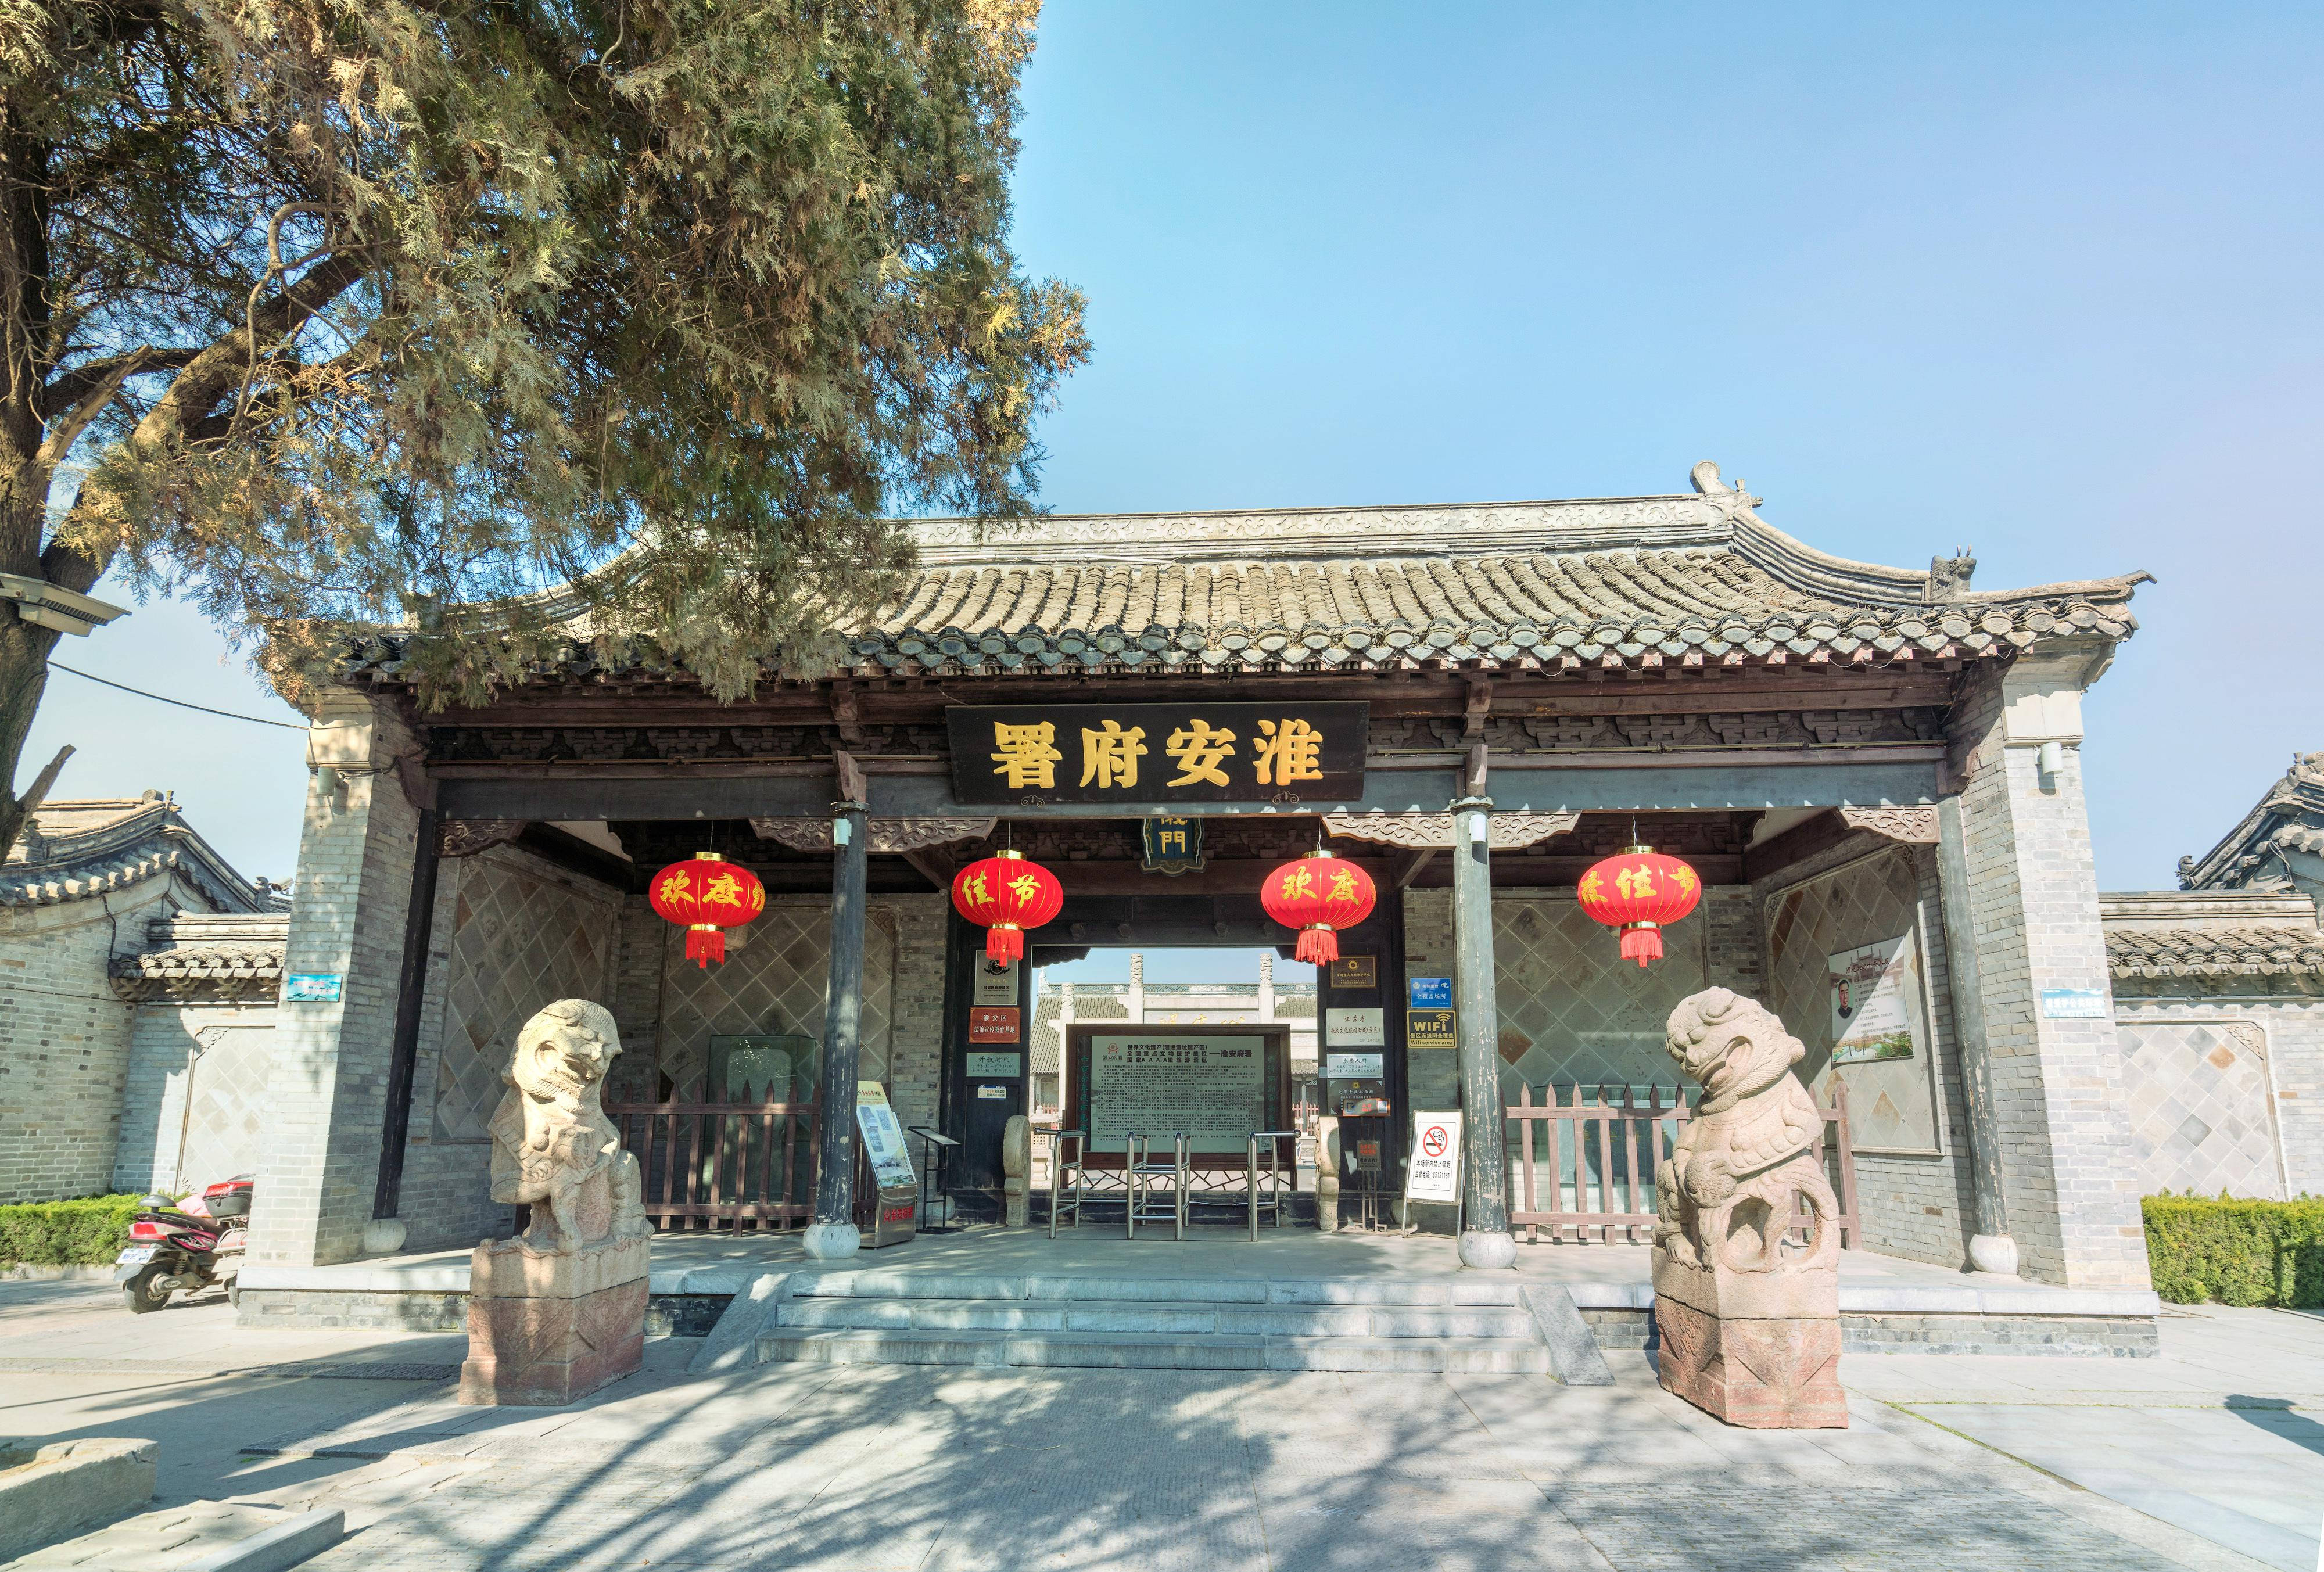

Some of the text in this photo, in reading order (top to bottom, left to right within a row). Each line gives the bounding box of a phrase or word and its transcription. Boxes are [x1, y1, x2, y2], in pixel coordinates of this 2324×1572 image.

[1159, 817, 1188, 854] 門
[1416, 1160, 1451, 1168] 本场所内禁止吸烟
